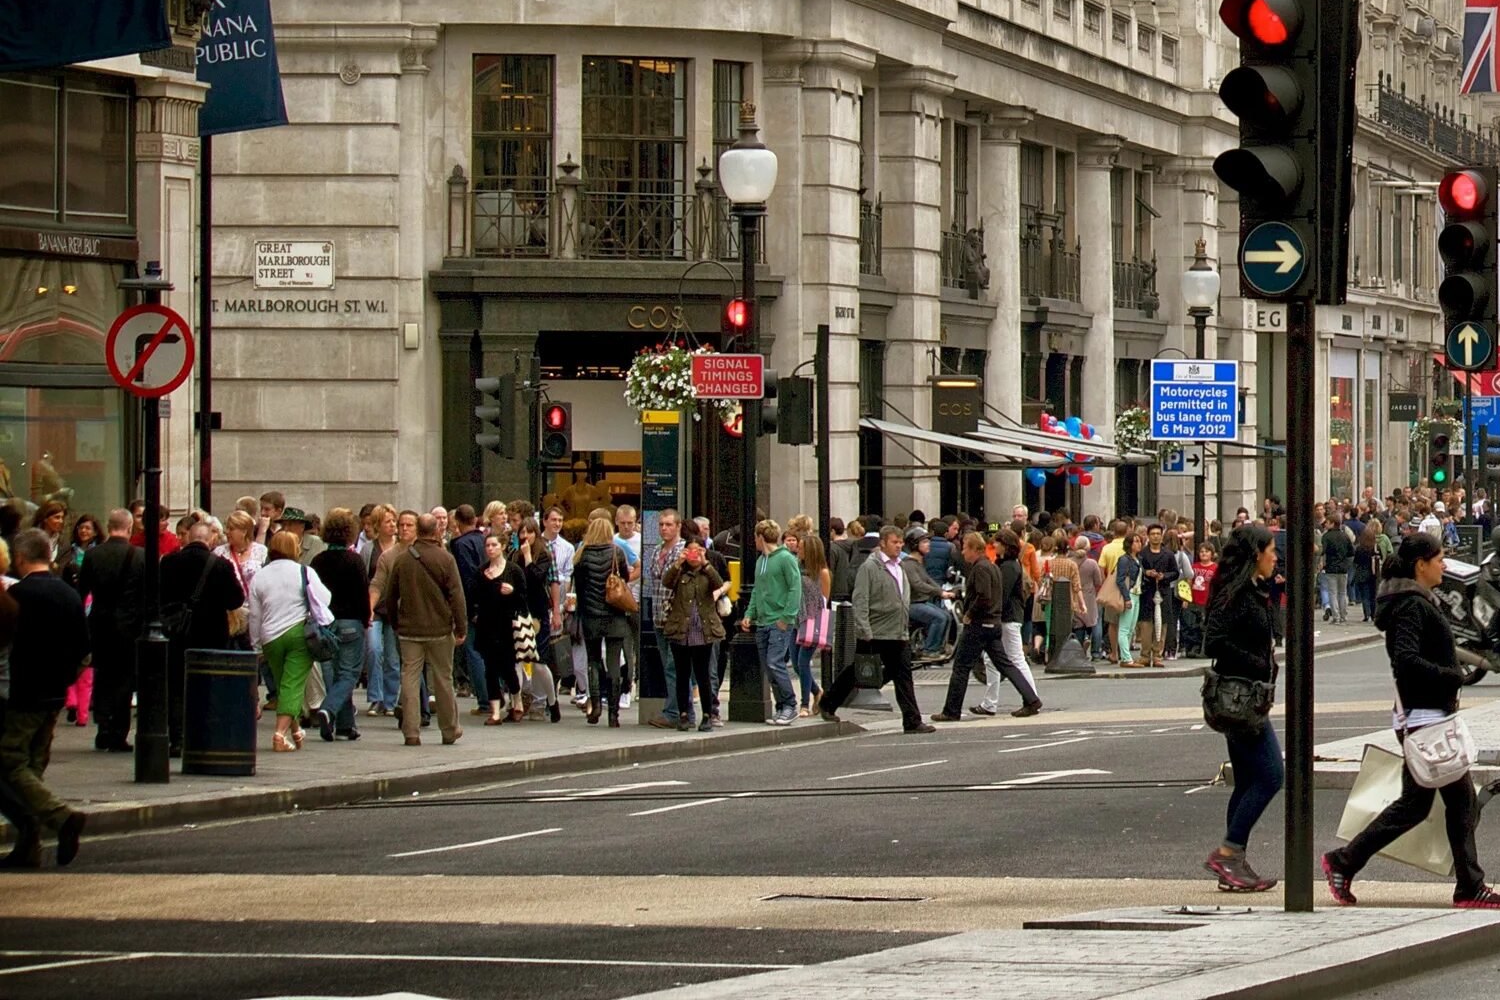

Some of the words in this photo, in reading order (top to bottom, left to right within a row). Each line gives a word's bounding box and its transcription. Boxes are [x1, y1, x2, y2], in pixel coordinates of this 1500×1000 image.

[259, 243, 292, 254] GREAT
[258, 256, 330, 266] MARLBOROUGH
[258, 268, 294, 279] STREET
[224, 299, 339, 313] MARLBOROUGH
[627, 305, 683, 329] COS
[704, 359, 750, 369] SIGNAL
[701, 371, 753, 381] TIMINGS
[696, 383, 758, 394] CHANGED
[1160, 386, 1228, 398] Motorcycles
[938, 403, 972, 416] COS
[1160, 399, 1214, 411] permitted
[1217, 400, 1228, 410] in
[1156, 411, 1175, 422] bus
[1178, 411, 1202, 422] lane
[1205, 411, 1232, 422] from
[1161, 424, 1169, 434] 6
[1173, 424, 1195, 436] May
[1198, 424, 1226, 435] 2012
